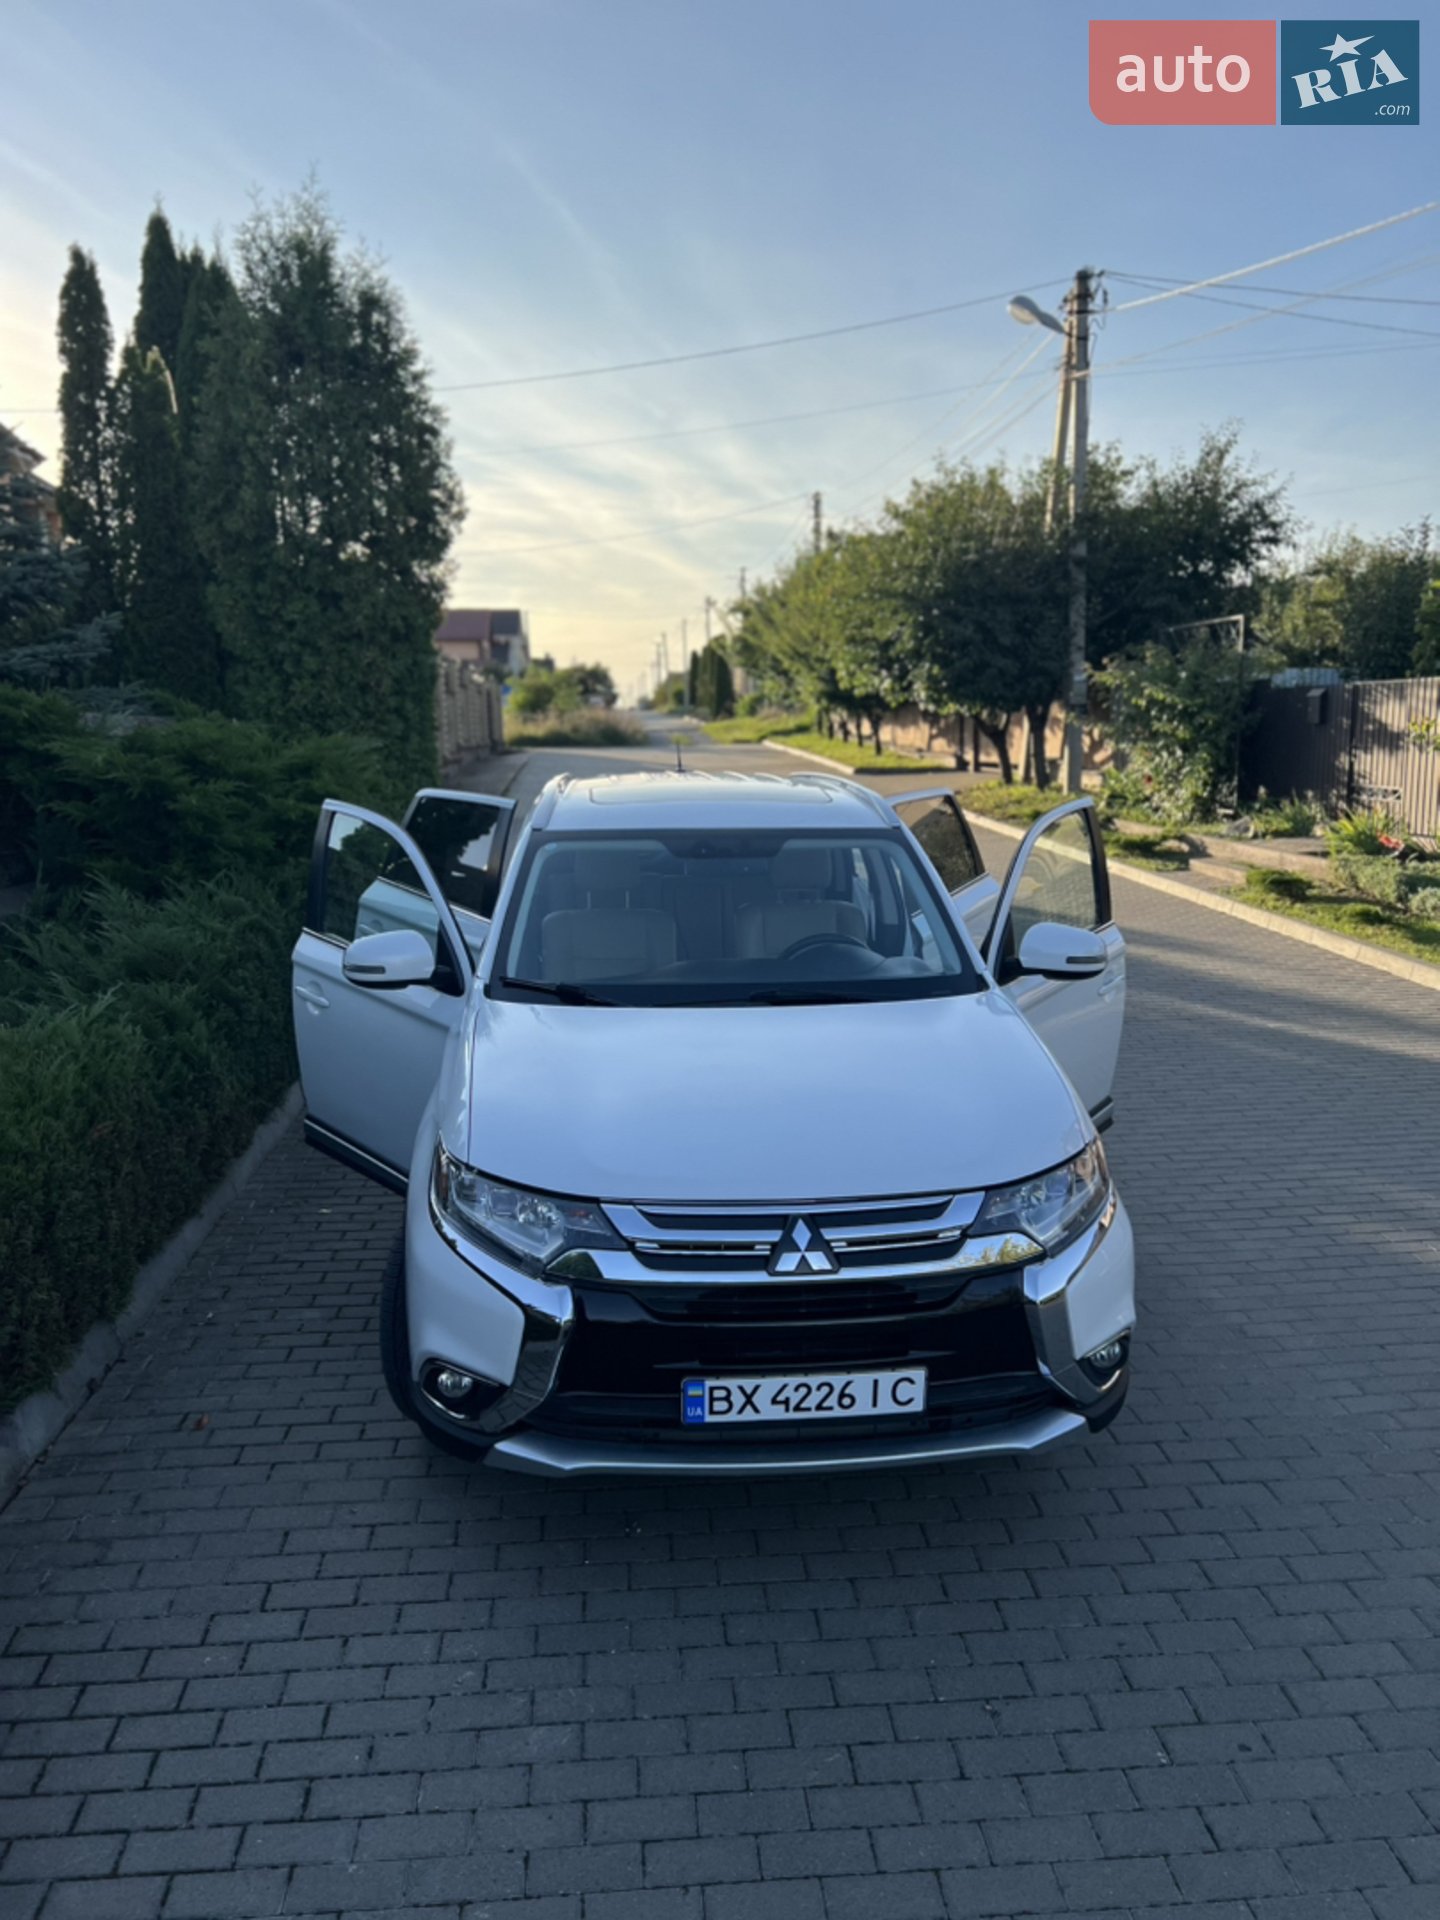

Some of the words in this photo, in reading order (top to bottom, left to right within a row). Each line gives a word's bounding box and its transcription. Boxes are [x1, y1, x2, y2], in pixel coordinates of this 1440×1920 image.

[707, 1384, 762, 1416] BX
[770, 1380, 856, 1413] 4226
[871, 1377, 917, 1408] IC
[687, 1407, 703, 1417] UA
